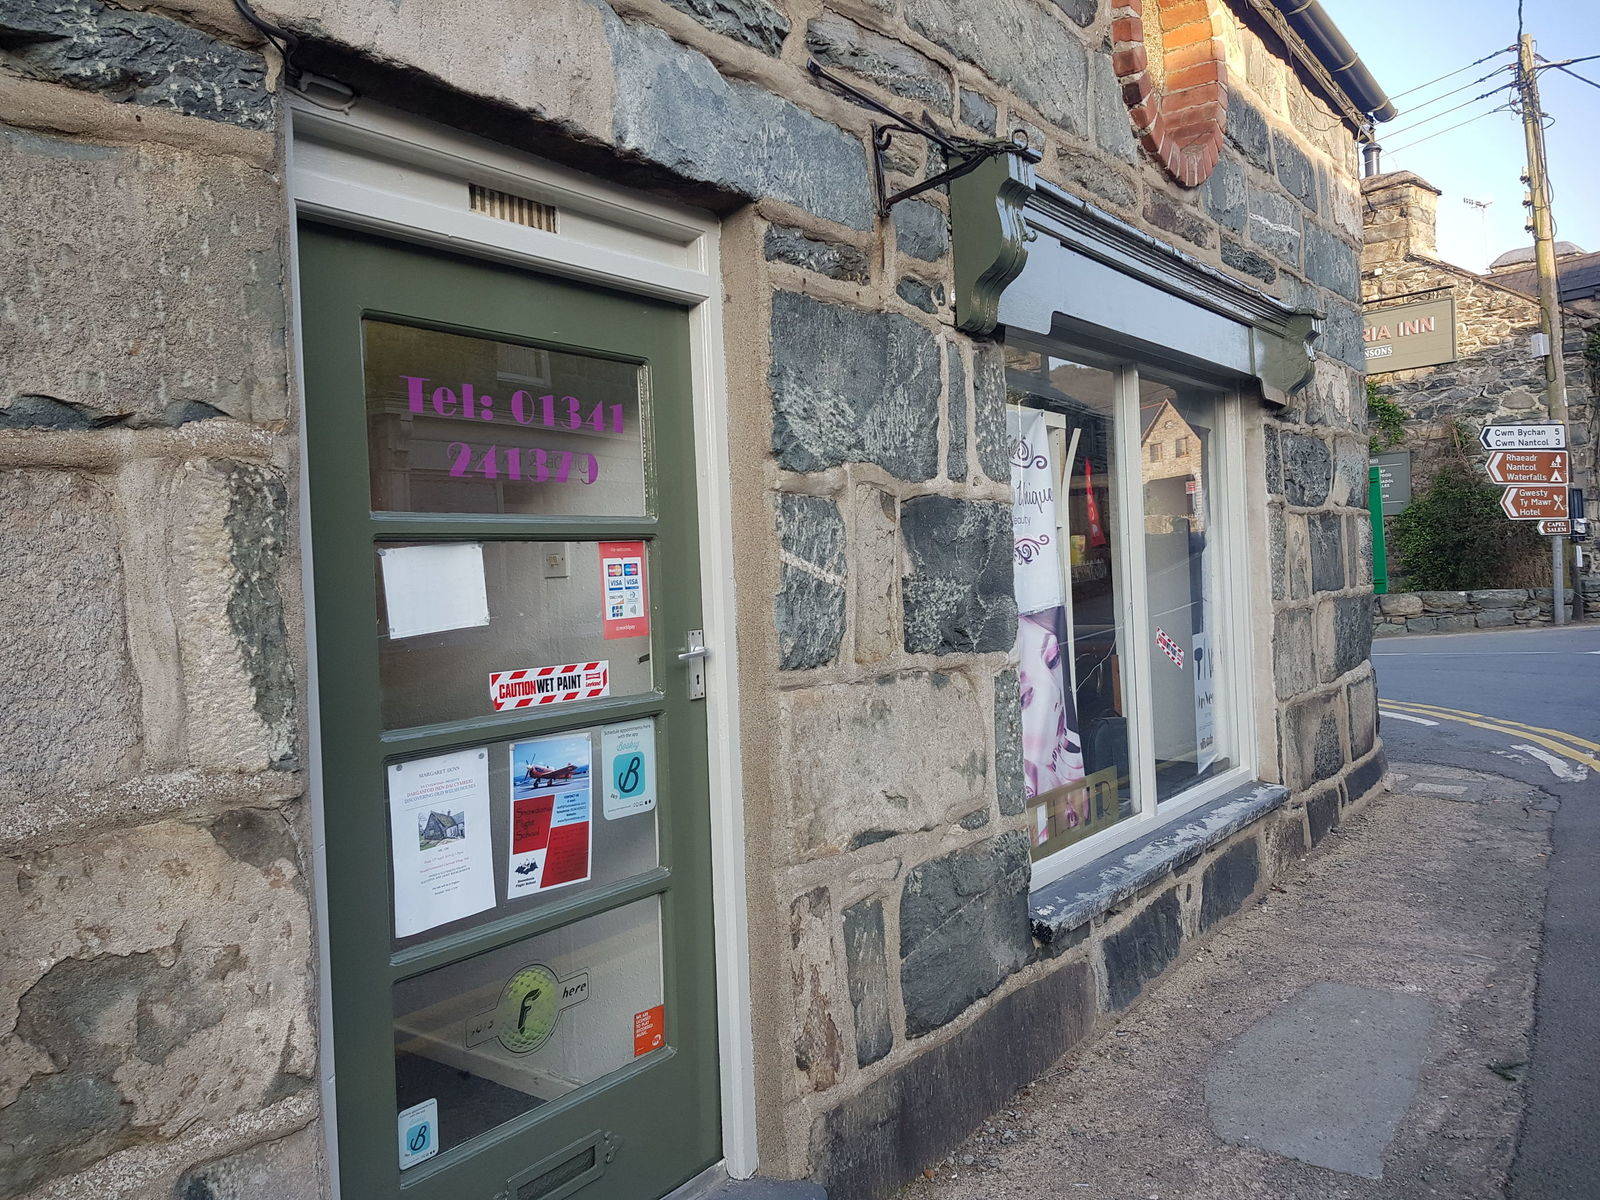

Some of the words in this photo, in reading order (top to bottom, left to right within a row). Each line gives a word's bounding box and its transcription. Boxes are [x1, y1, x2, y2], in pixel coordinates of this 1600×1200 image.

[1396, 316, 1435, 337] INN
[400, 376, 493, 421] Tel:
[511, 390, 624, 434] 01341
[1494, 429, 1515, 437] Cwm
[1517, 428, 1546, 437] Bychan
[1554, 428, 1560, 436] 5
[1495, 439, 1516, 447] Cwm
[1518, 439, 1549, 447] Nantcol
[1555, 438, 1561, 446] 3
[1506, 454, 1537, 462] Rhaeadr
[447, 441, 599, 485] 241379
[1506, 463, 1537, 471] Nantcol
[1506, 473, 1547, 481] Waterfalls
[1519, 489, 1548, 498] Gwesty
[1520, 498, 1529, 506] Ty
[1531, 498, 1552, 506] Mawr
[1519, 508, 1541, 516] Hotel
[626, 578, 639, 586] VISA
[499, 681, 537, 700] CAUTION
[536, 677, 555, 694] WET
[557, 674, 582, 692] PAINT
[563, 982, 586, 999] here
